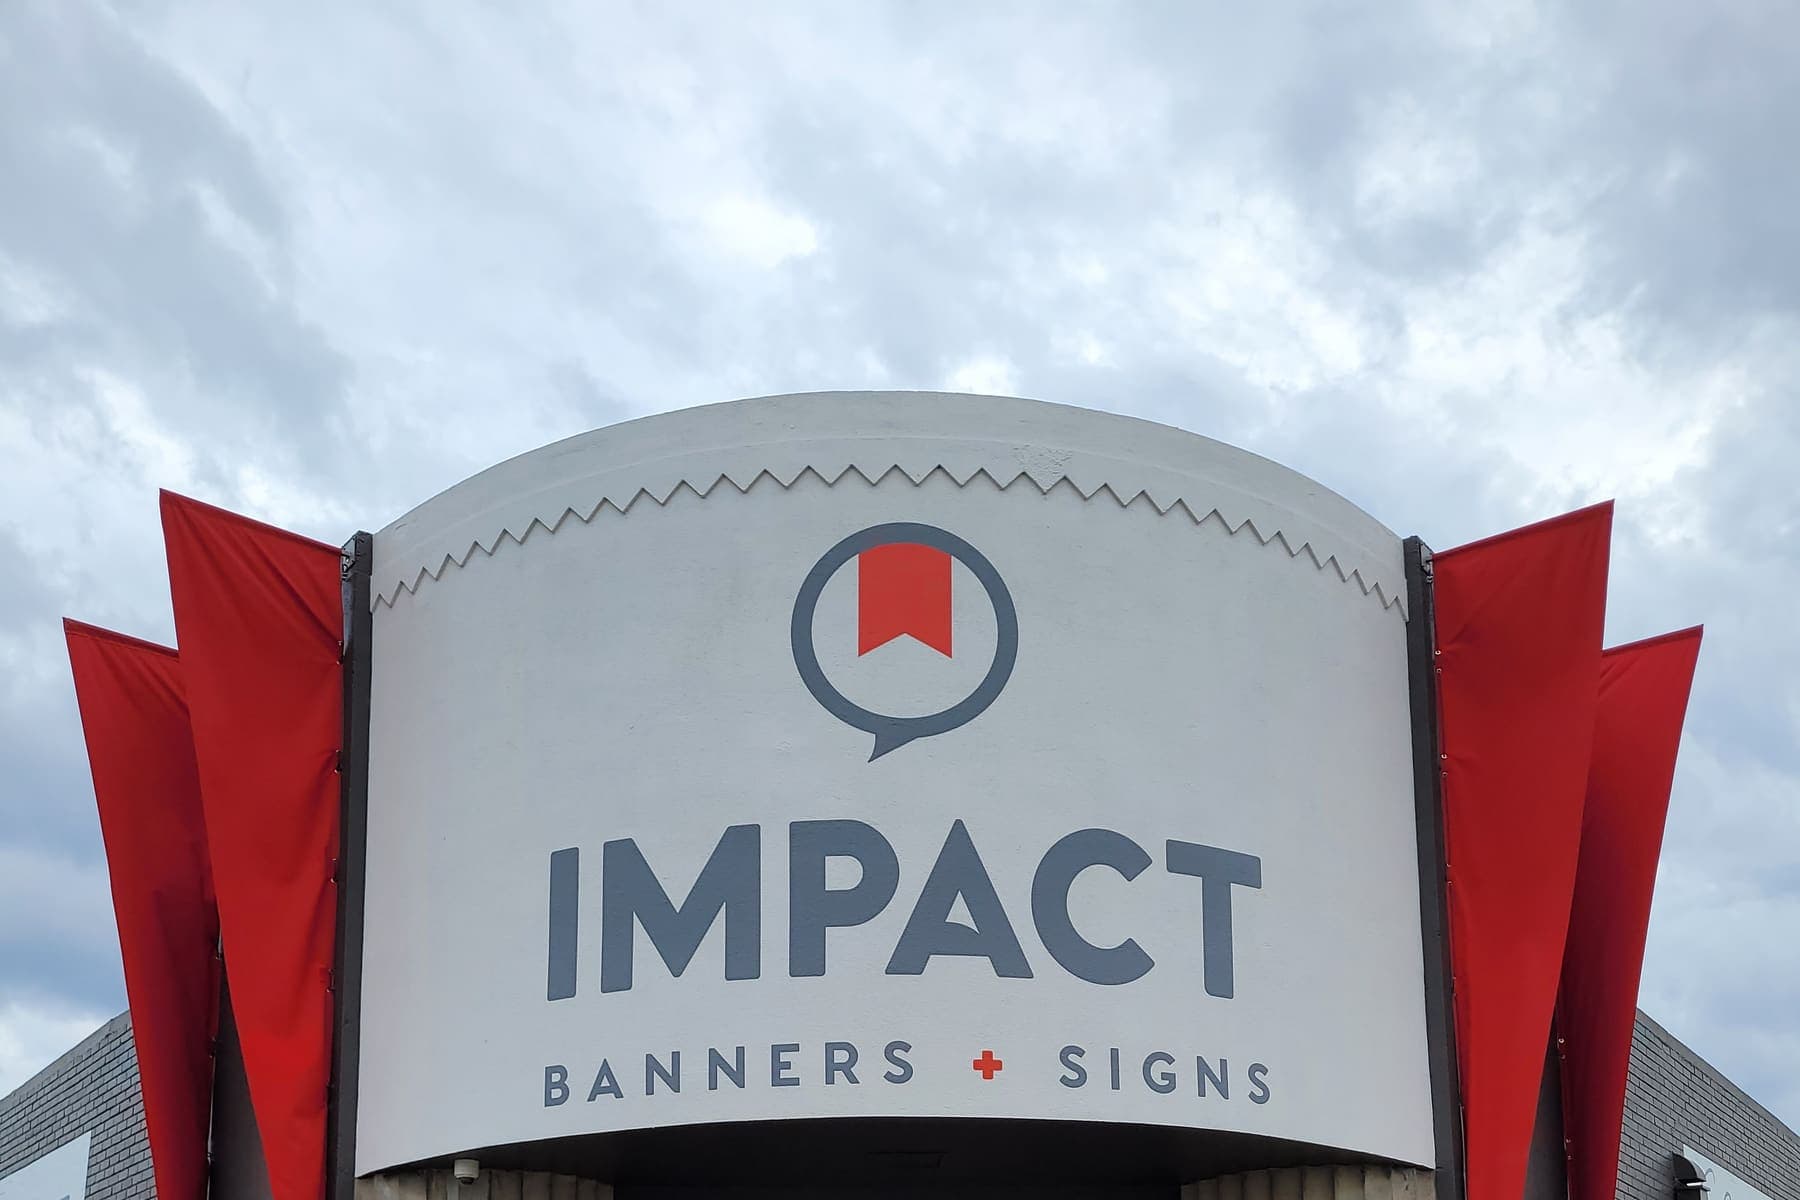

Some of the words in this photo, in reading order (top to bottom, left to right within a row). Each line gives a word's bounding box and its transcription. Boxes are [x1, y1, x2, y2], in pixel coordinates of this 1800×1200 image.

[547, 818, 1262, 1002] IMPACT
[543, 1040, 914, 1108] BANNERS
[1058, 1045, 1271, 1105] SIGNS
